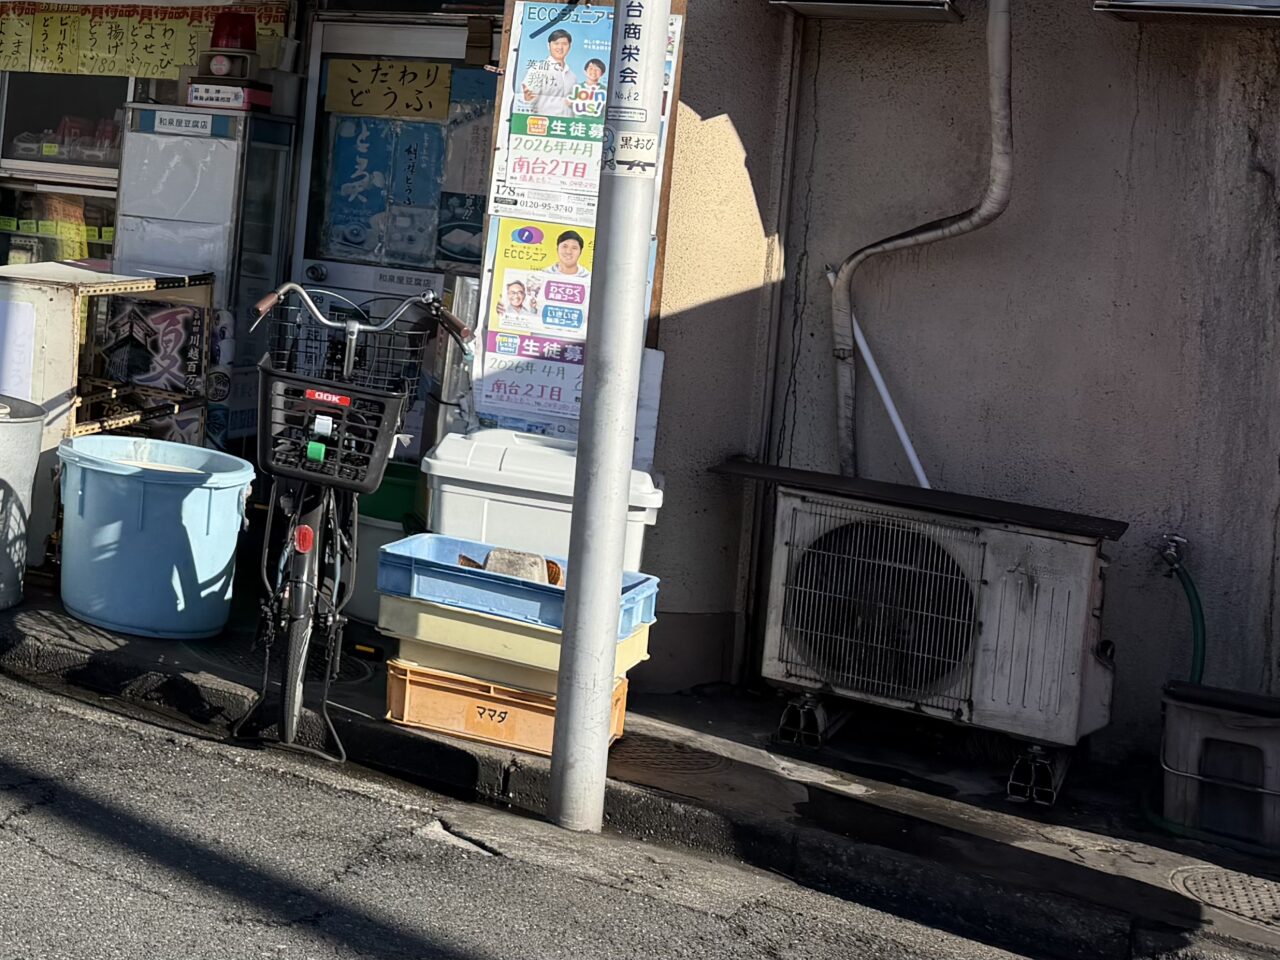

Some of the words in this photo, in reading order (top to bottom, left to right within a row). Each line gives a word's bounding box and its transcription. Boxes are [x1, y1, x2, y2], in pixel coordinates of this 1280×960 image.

[107, 24, 125, 59] 揚げ
[126, 24, 144, 65] どうふ
[142, 25, 156, 55] よせ
[158, 27, 175, 70] わさび
[347, 63, 440, 89] こだわり
[350, 87, 433, 112] どうふ
[568, 86, 606, 102] Join
[575, 101, 602, 115] us!
[159, 116, 208, 130] 和泉屋豆腐店
[620, 135, 656, 151] 黒おび
[512, 155, 588, 179] 南台2丁目
[503, 248, 548, 262] ECCシニア
[379, 272, 432, 289] 和泉屋豆腐店
[491, 378, 562, 401] 南台2丁目
